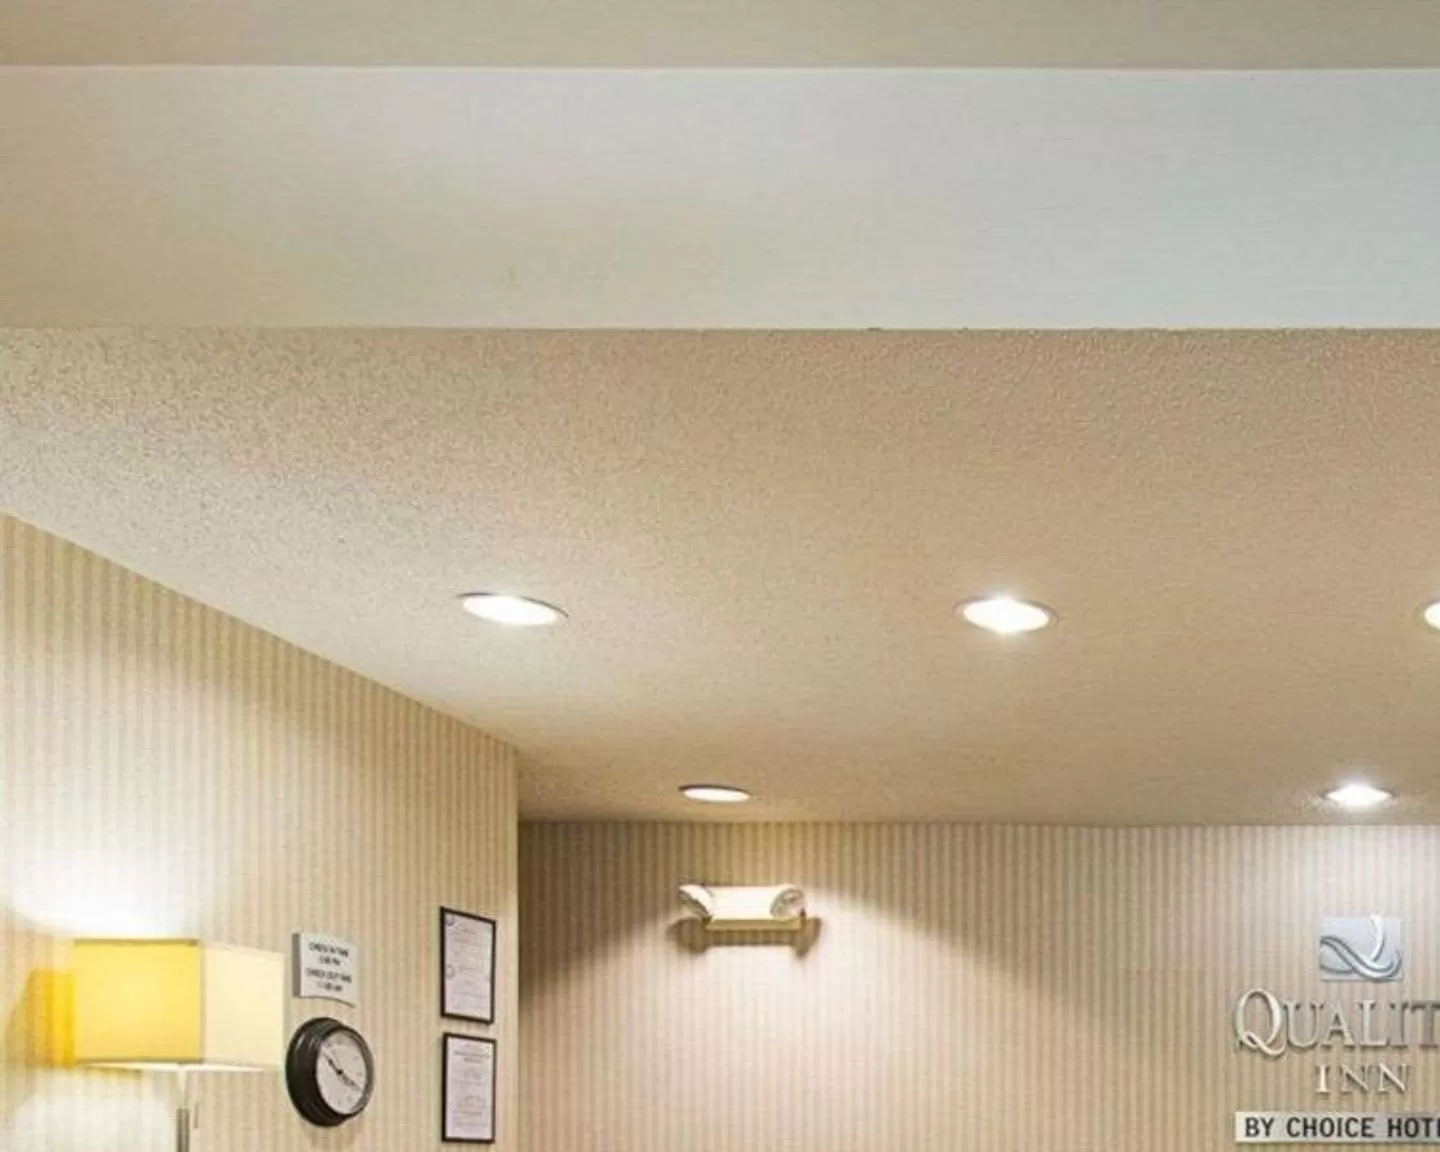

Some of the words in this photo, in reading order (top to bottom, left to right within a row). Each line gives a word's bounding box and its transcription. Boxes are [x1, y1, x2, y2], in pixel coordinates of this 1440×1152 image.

[1314, 1063, 1410, 1094] INN
[1245, 1117, 1276, 1138] BY
[1286, 1117, 1375, 1138] CHOICE
